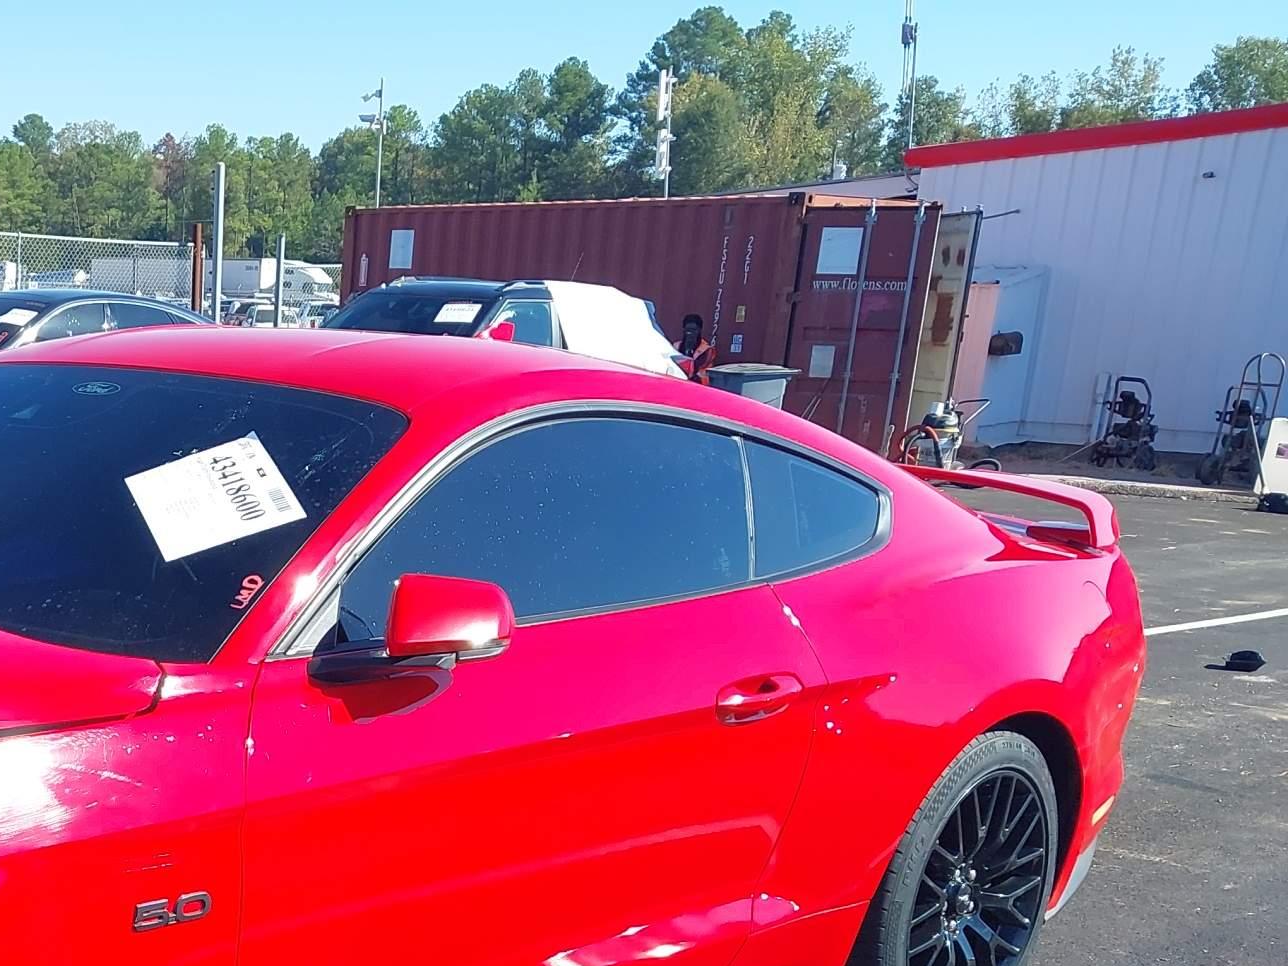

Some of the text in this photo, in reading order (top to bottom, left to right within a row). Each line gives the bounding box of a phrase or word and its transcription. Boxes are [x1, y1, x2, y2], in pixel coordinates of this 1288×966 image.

[812, 277, 907, 291] www.floens.com
[210, 456, 266, 521] 43418600
[134, 890, 212, 932] 5.0
